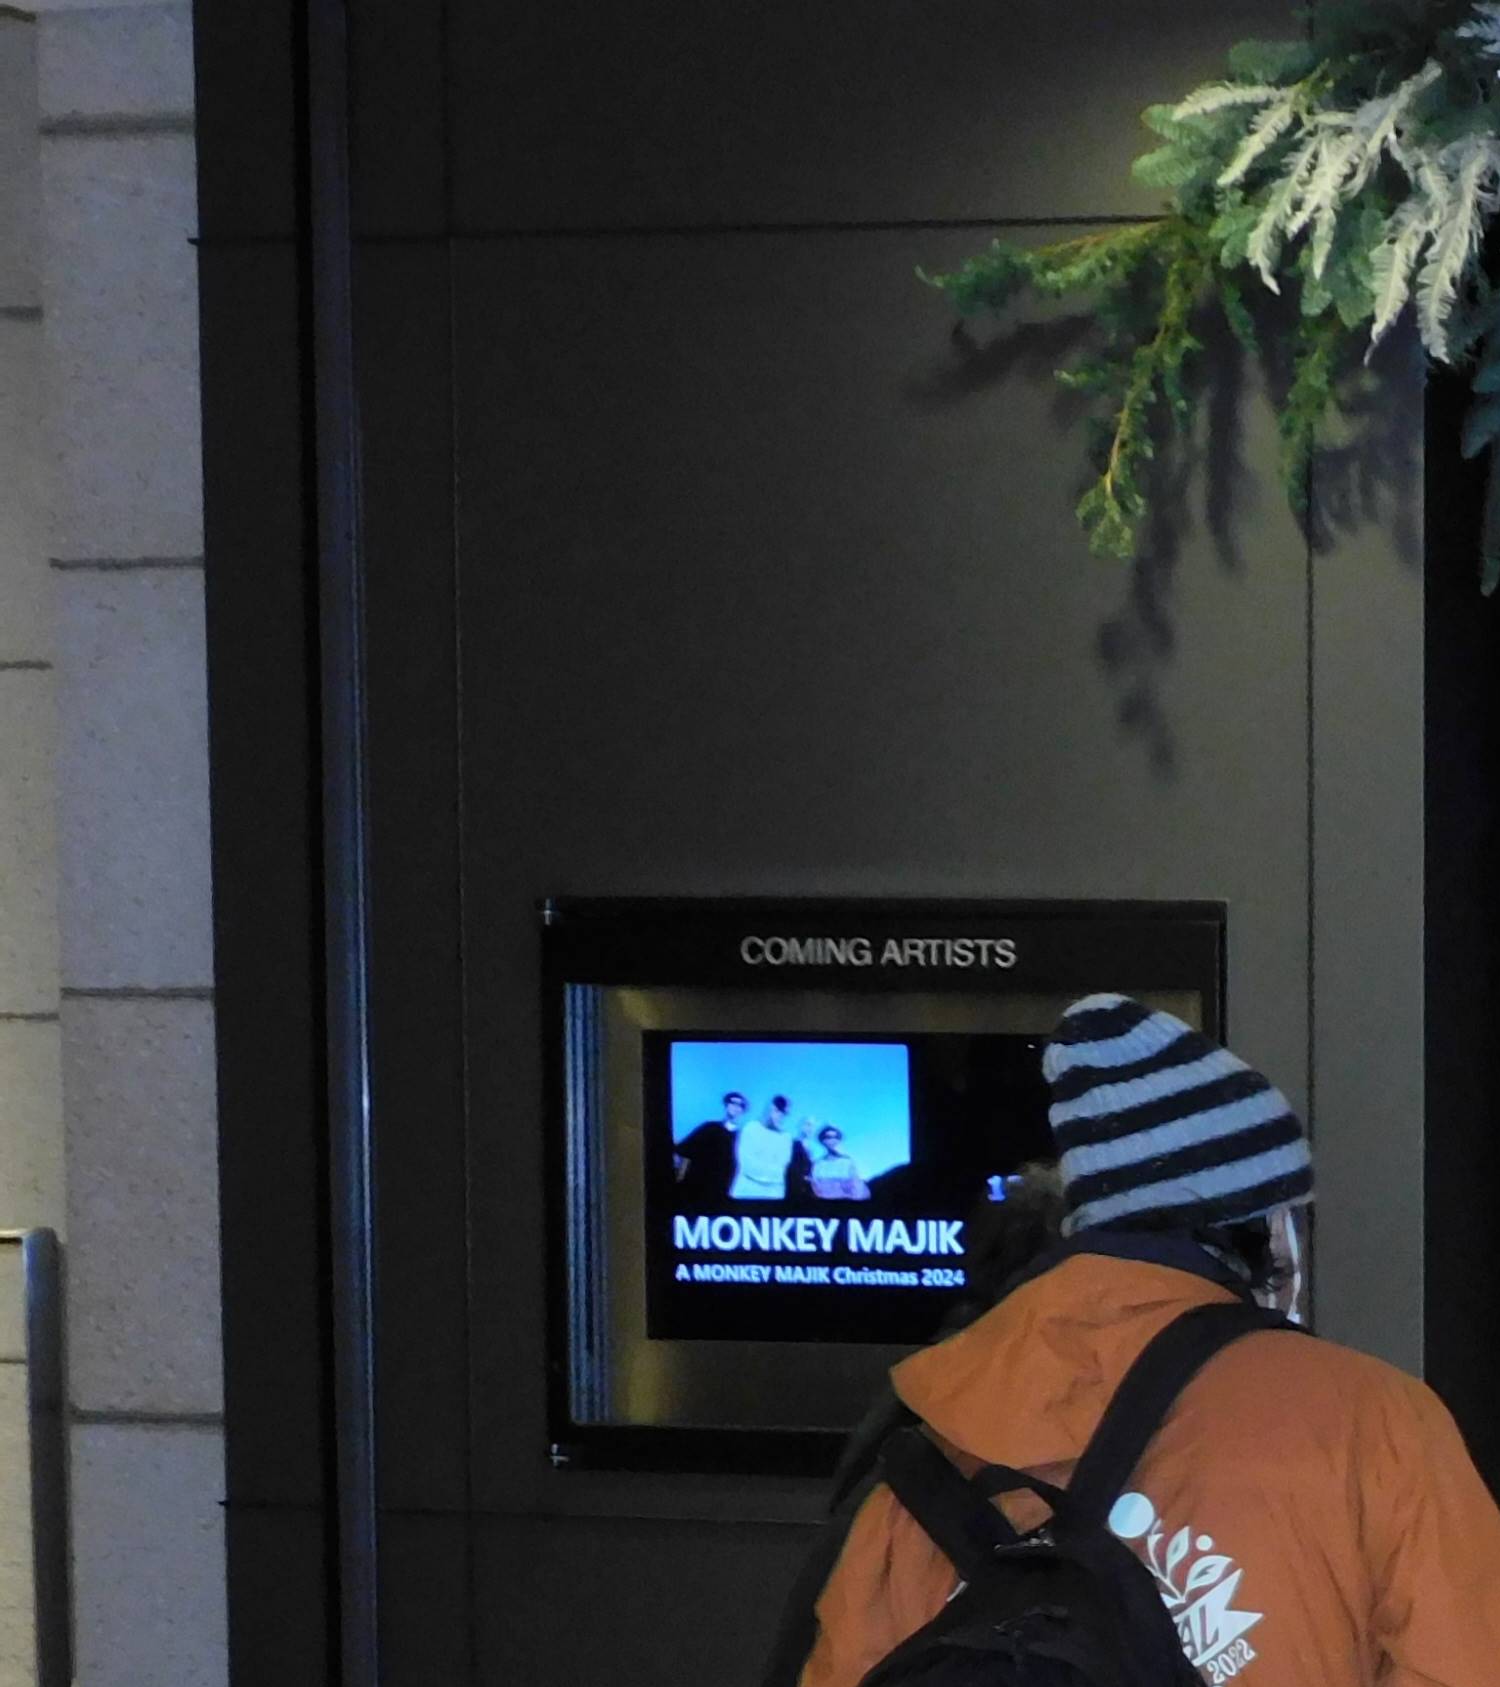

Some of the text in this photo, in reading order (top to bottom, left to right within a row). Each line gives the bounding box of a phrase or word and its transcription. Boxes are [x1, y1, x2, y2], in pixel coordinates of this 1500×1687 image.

[740, 935, 1017, 968] COMING ARTISTS
[673, 1215, 965, 1256] MONKEY MAJIK
[675, 1264, 965, 1287] A MONKEY MAJIK Christmas 2024
[1206, 1637, 1257, 1684] 2022
